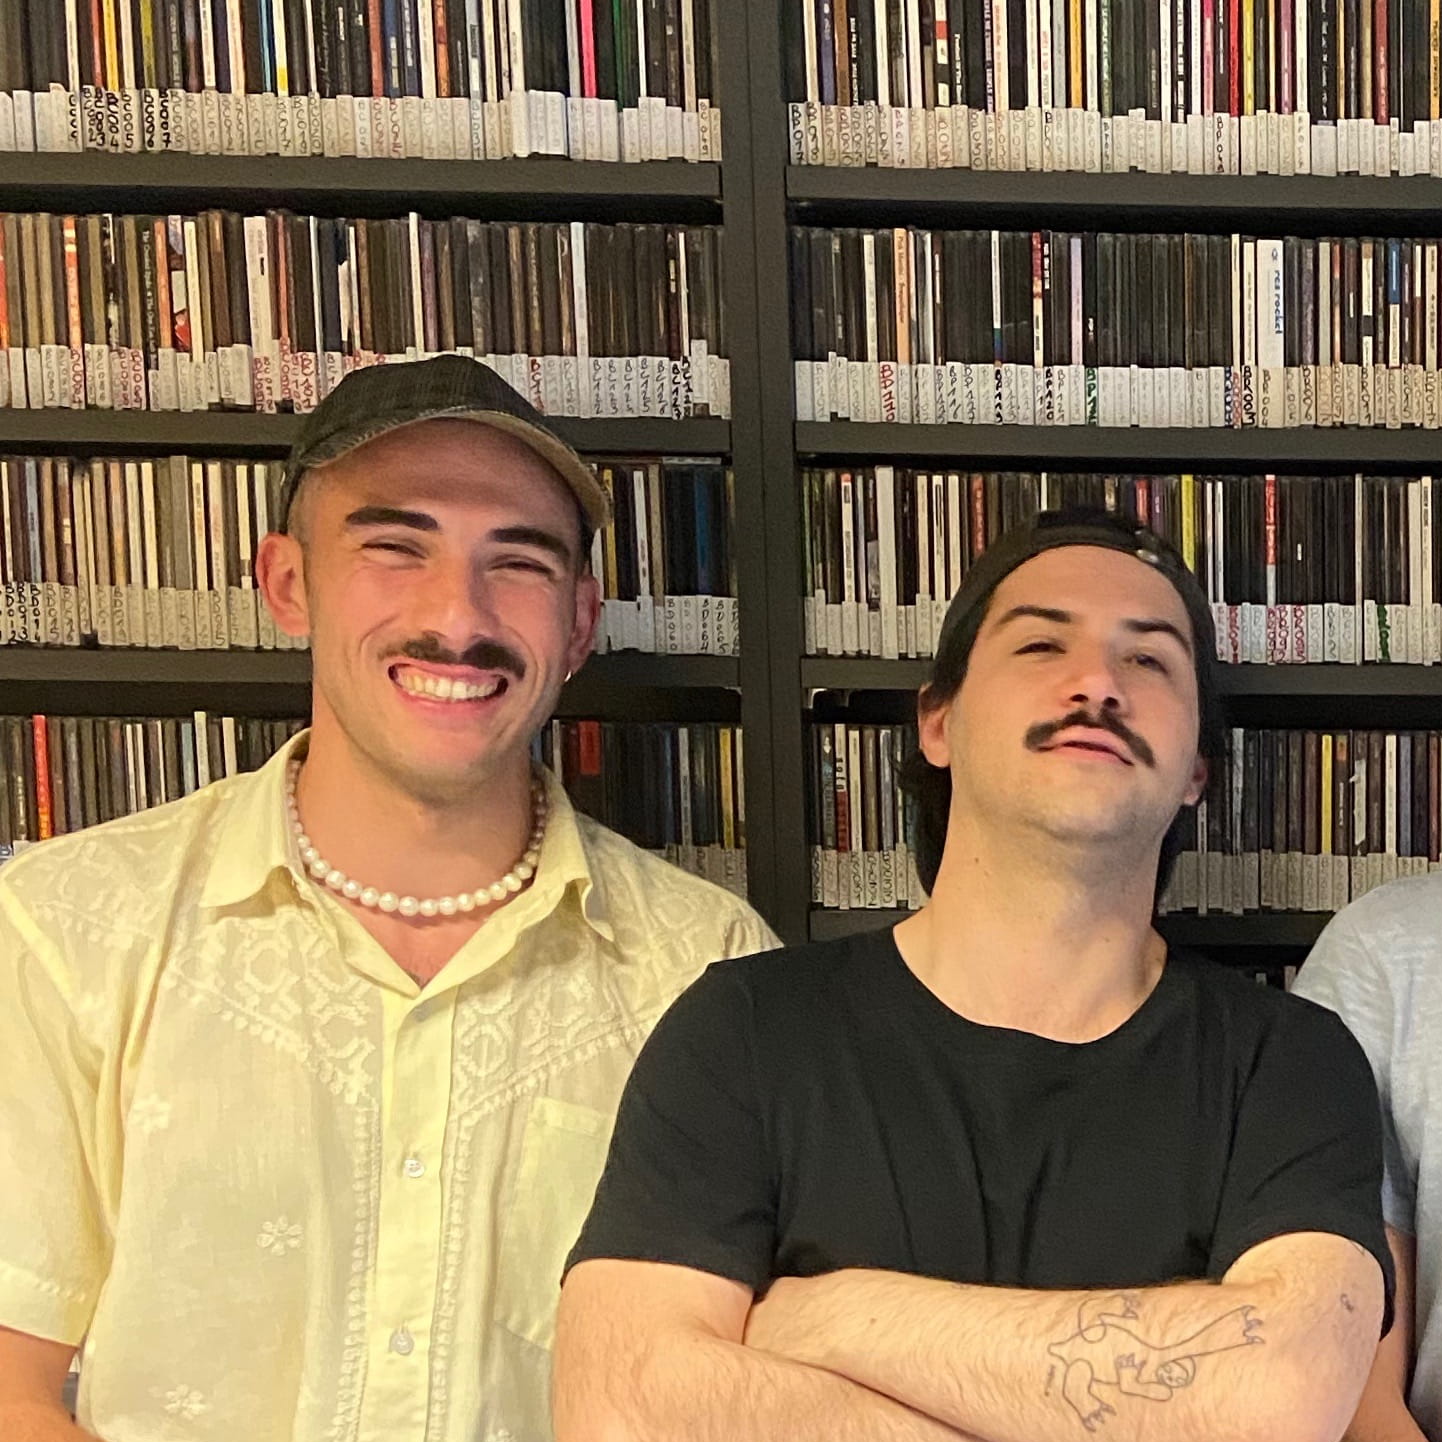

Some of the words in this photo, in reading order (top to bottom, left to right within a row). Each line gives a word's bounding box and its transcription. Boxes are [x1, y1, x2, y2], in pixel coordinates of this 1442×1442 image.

[121, 91, 134, 148] BC005
[593, 359, 603, 415] BC122
[1242, 365, 1257, 426] BR003
